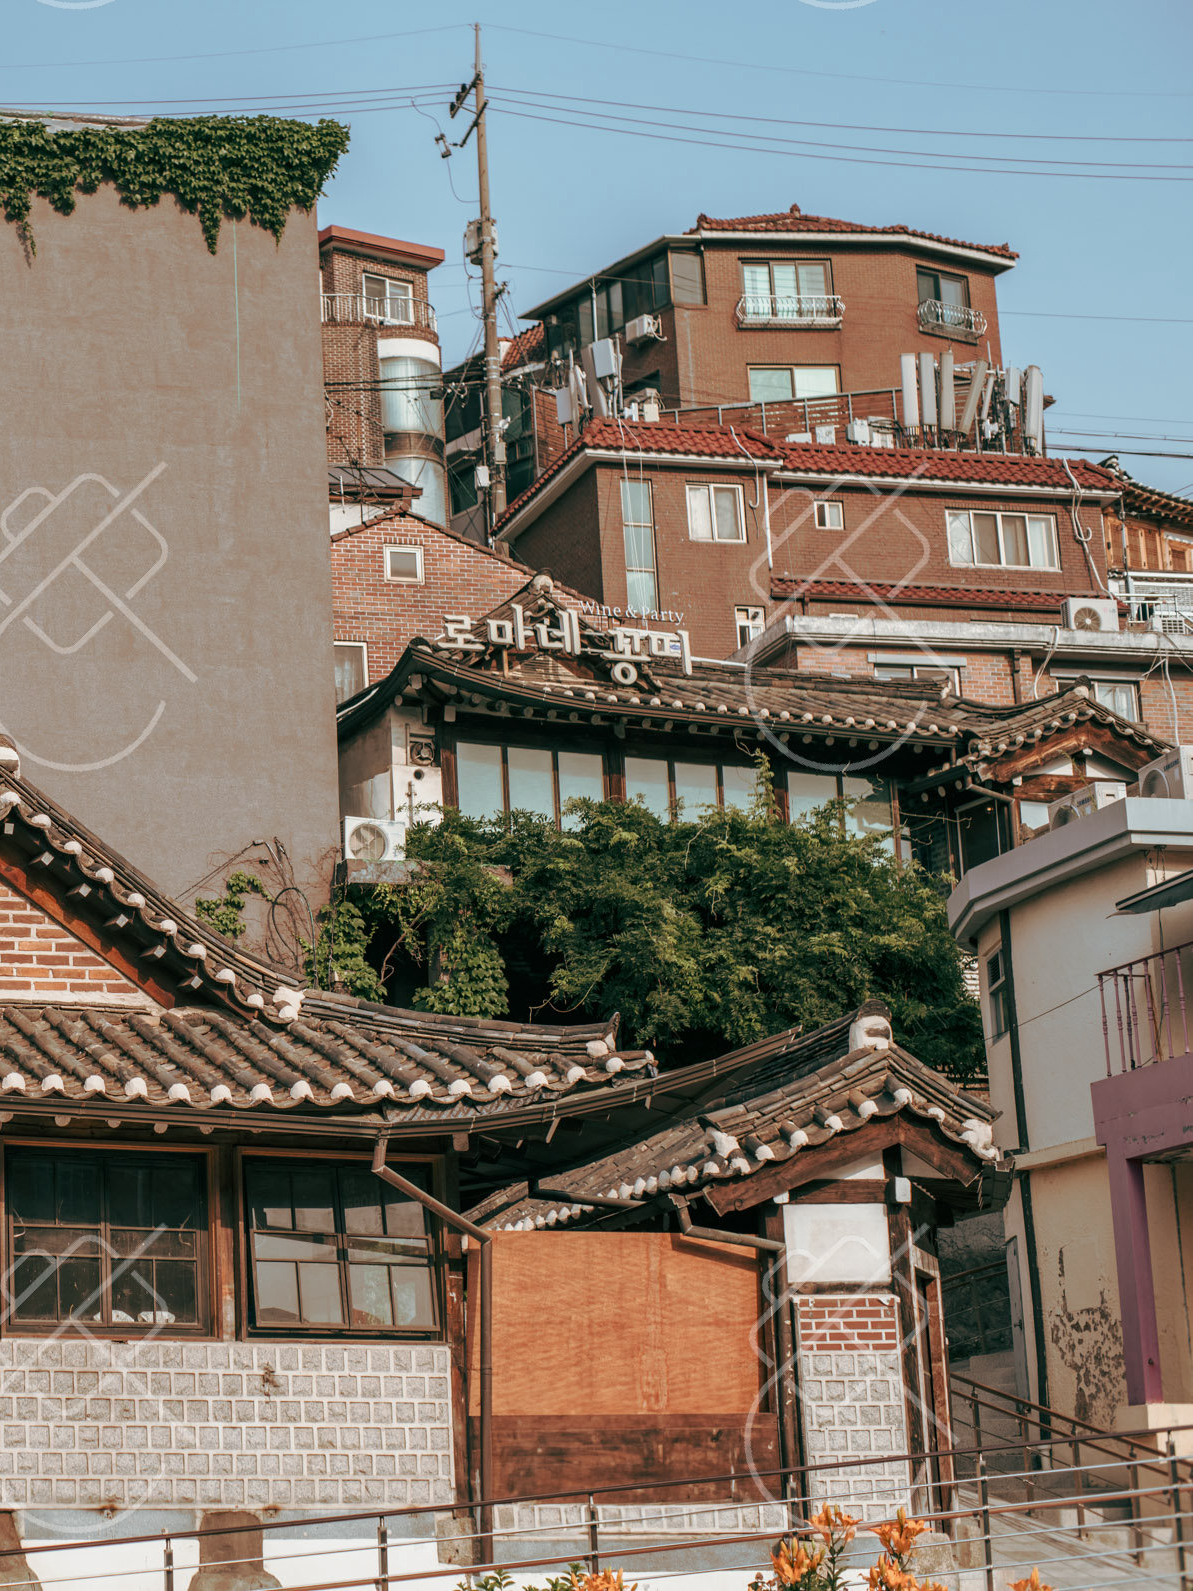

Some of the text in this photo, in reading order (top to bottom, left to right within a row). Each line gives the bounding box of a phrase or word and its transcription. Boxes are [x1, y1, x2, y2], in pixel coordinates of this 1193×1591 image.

[578, 600, 684, 626] Wine & Party
[435, 603, 693, 686] 로마네 꽁띠
